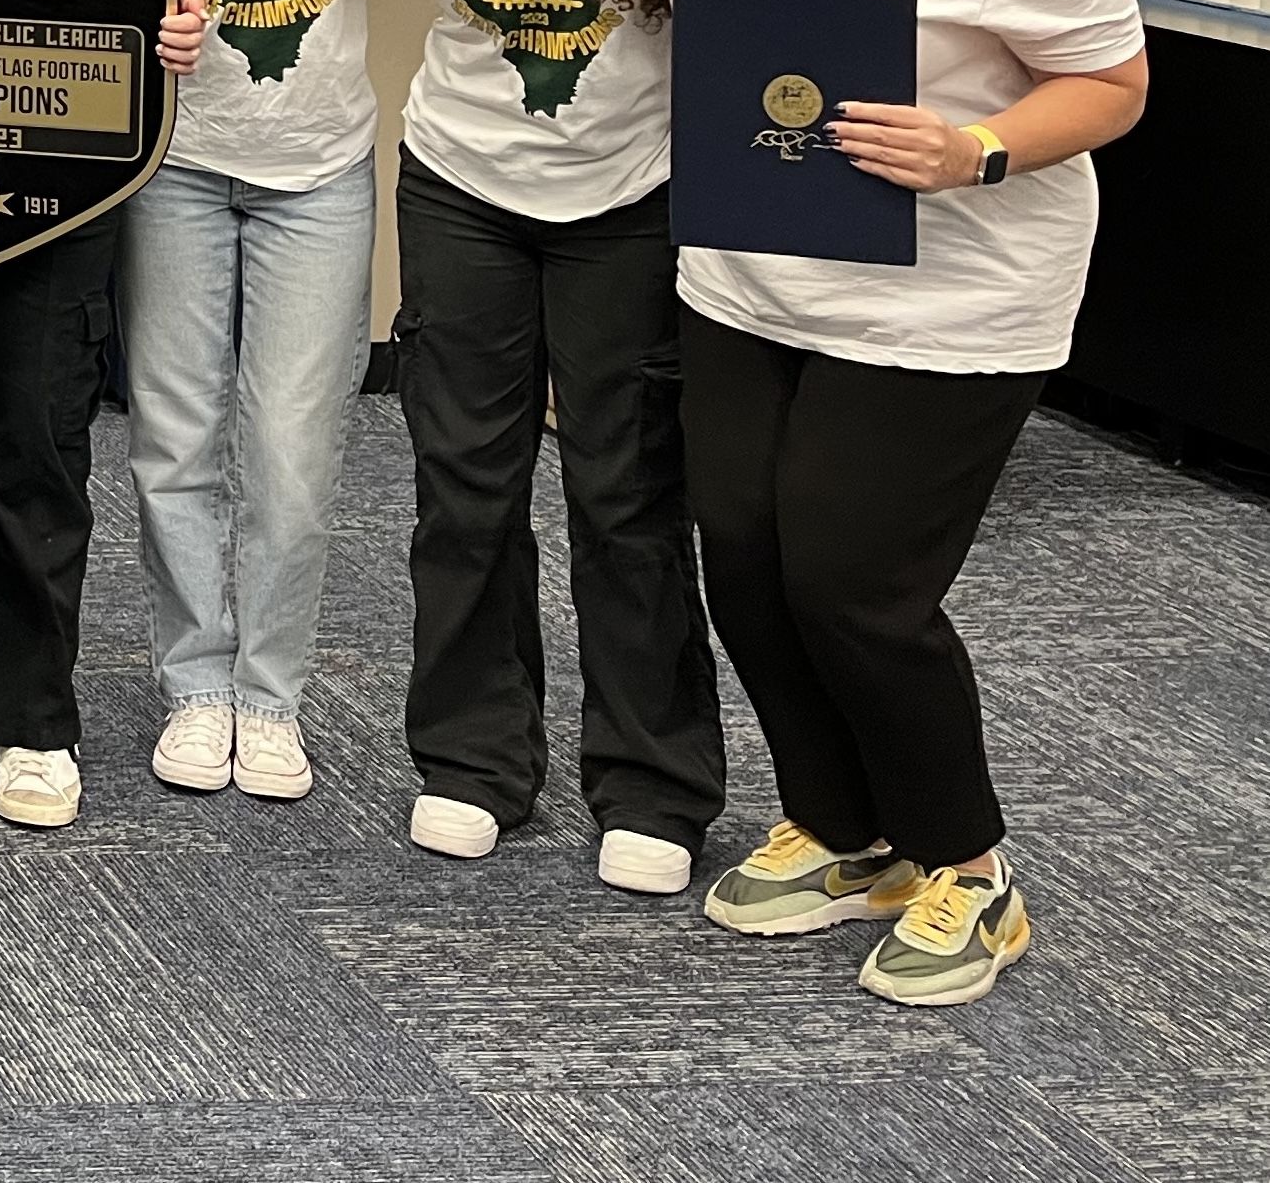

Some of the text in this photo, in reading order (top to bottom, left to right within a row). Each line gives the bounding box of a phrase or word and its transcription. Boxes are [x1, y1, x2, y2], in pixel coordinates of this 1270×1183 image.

[45, 27, 123, 50] LEAGUE
[504, 7, 626, 61] CHAMPIONS
[38, 60, 121, 84] FOOTBALL
[24, 196, 59, 216] 1913
